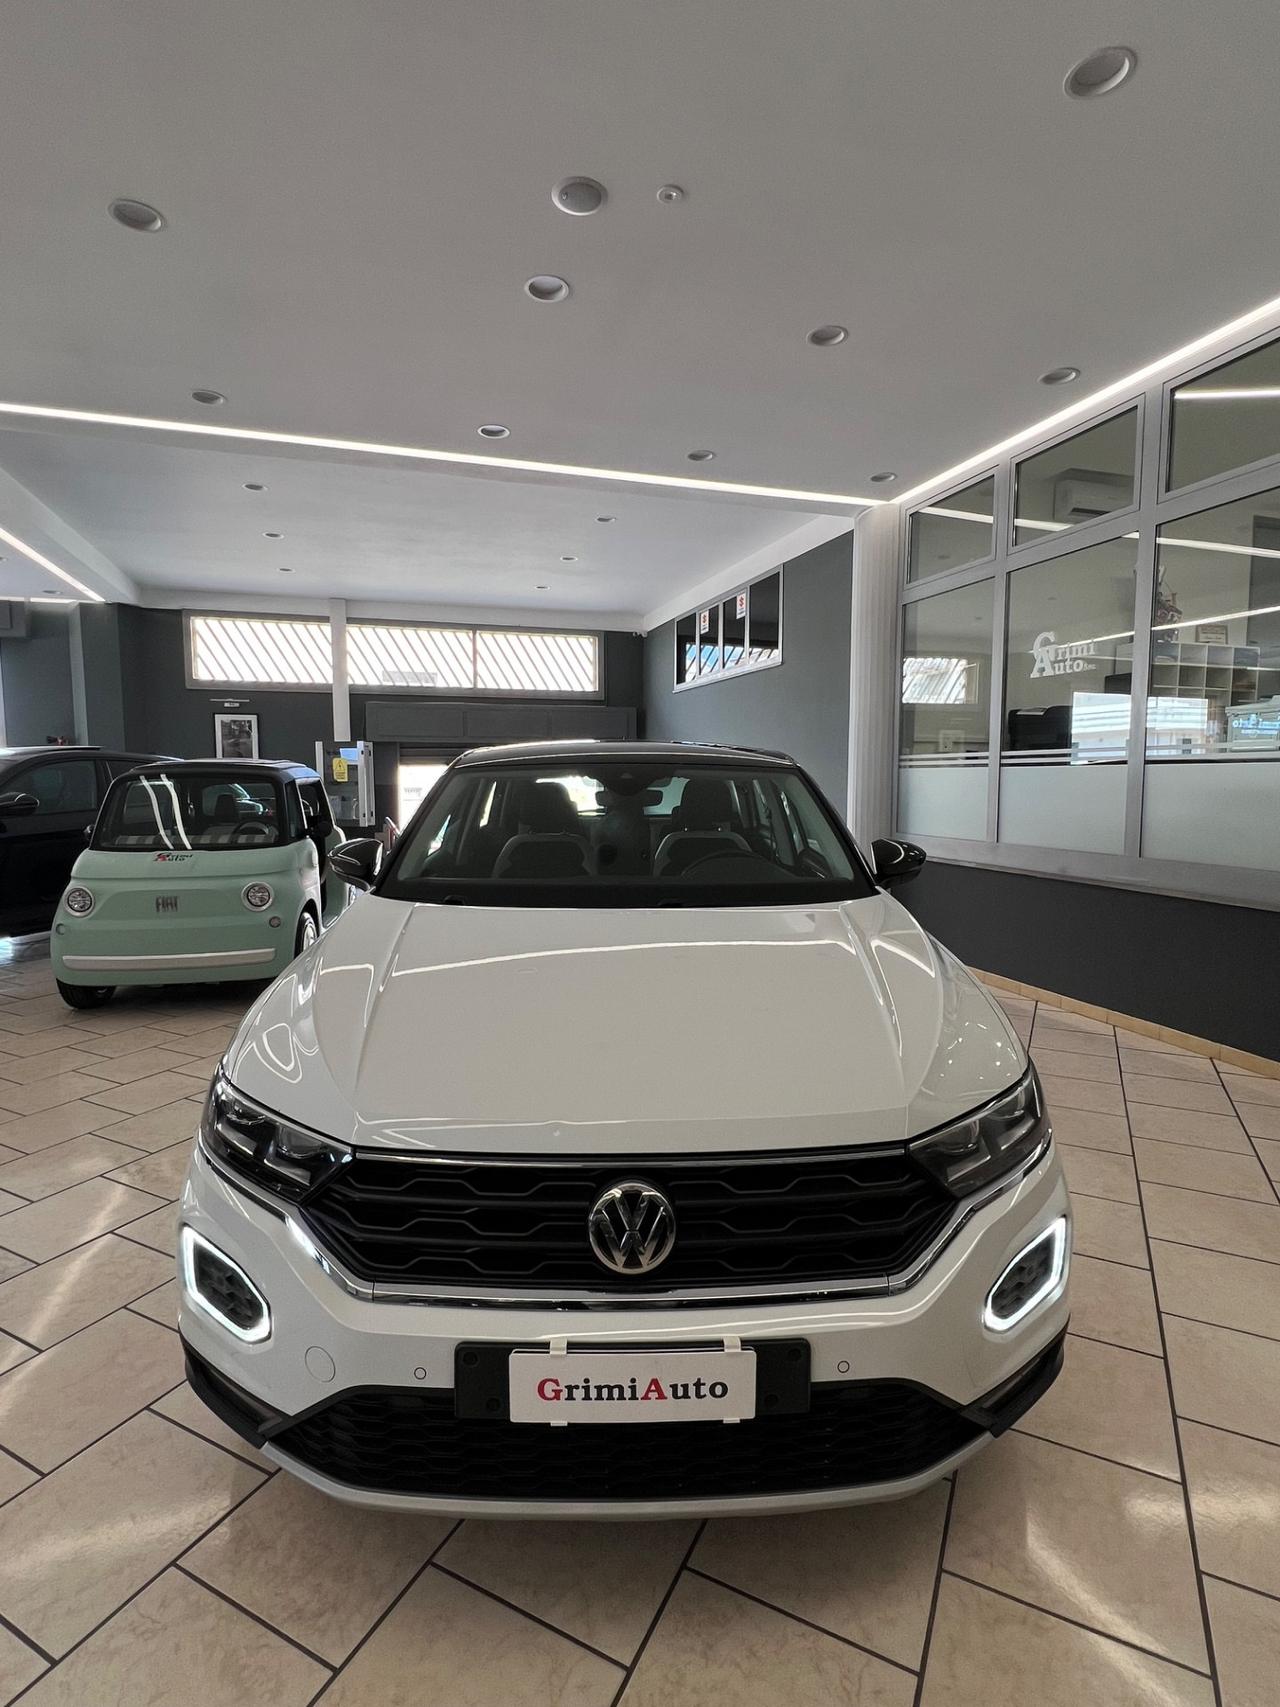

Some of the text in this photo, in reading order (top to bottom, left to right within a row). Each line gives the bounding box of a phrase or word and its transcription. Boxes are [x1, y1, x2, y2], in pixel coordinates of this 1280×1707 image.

[1030, 649, 1084, 678] Auto
[155, 895, 178, 912] FIAT
[537, 1377, 729, 1401] GrimiAuto
